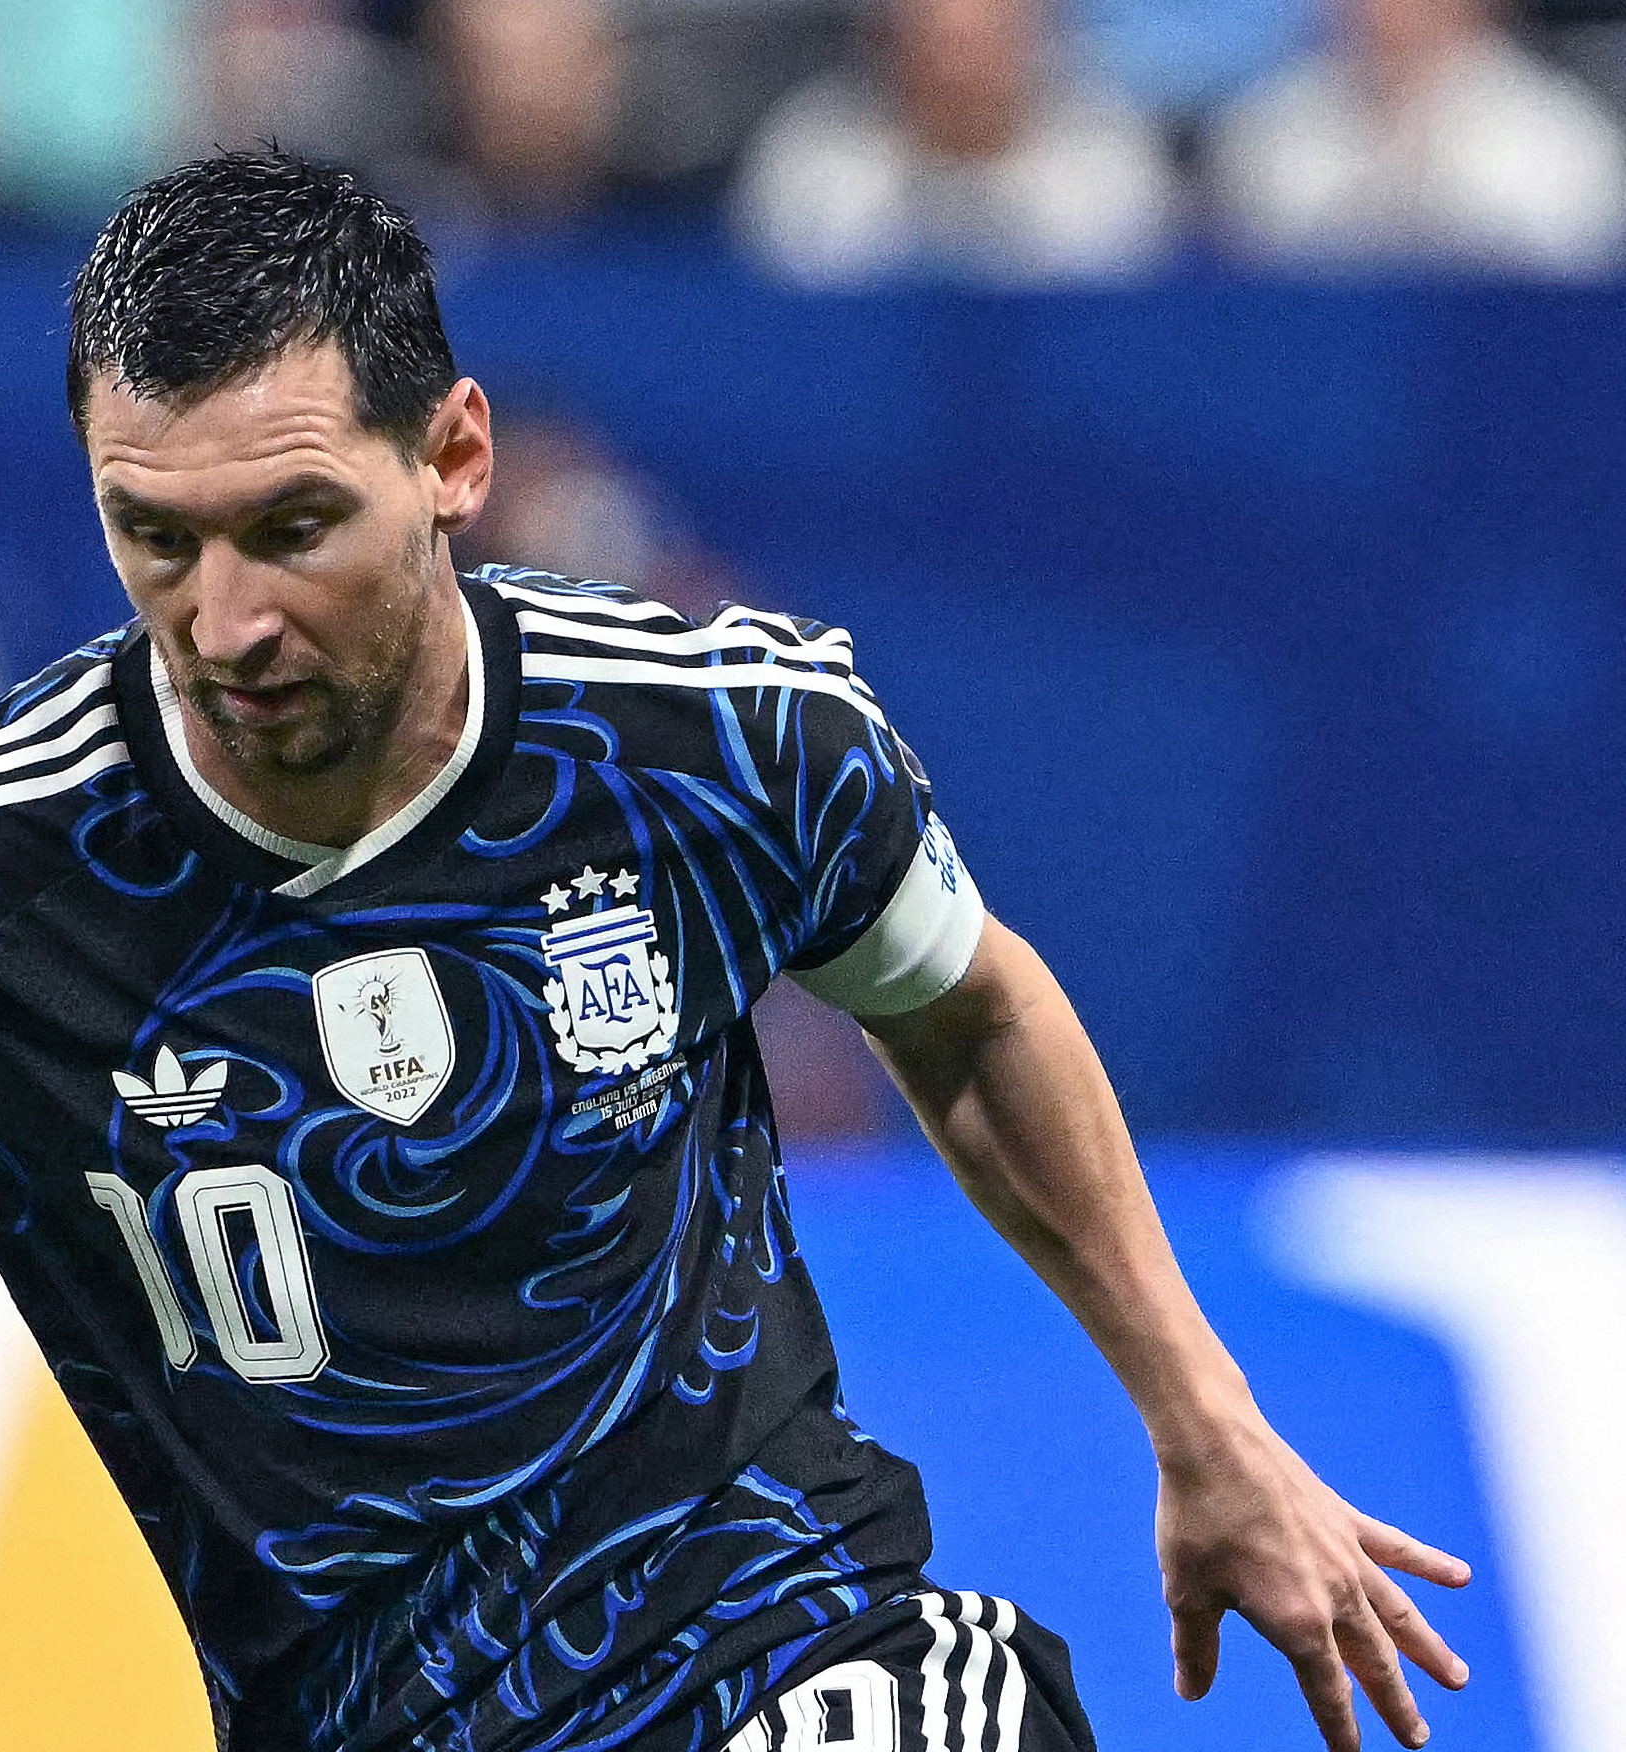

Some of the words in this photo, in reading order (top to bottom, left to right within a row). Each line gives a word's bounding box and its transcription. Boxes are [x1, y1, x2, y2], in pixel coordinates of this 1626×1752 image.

[579, 953, 649, 1024] AFA
[369, 1056, 424, 1085] FIFA
[385, 1086, 417, 1103] 2022
[571, 1090, 620, 1115] ENGLAND
[623, 1083, 638, 1098] VS
[615, 1094, 639, 1114] JULY
[614, 1099, 659, 1130] ATLANTA
[84, 1164, 331, 1384] 10
